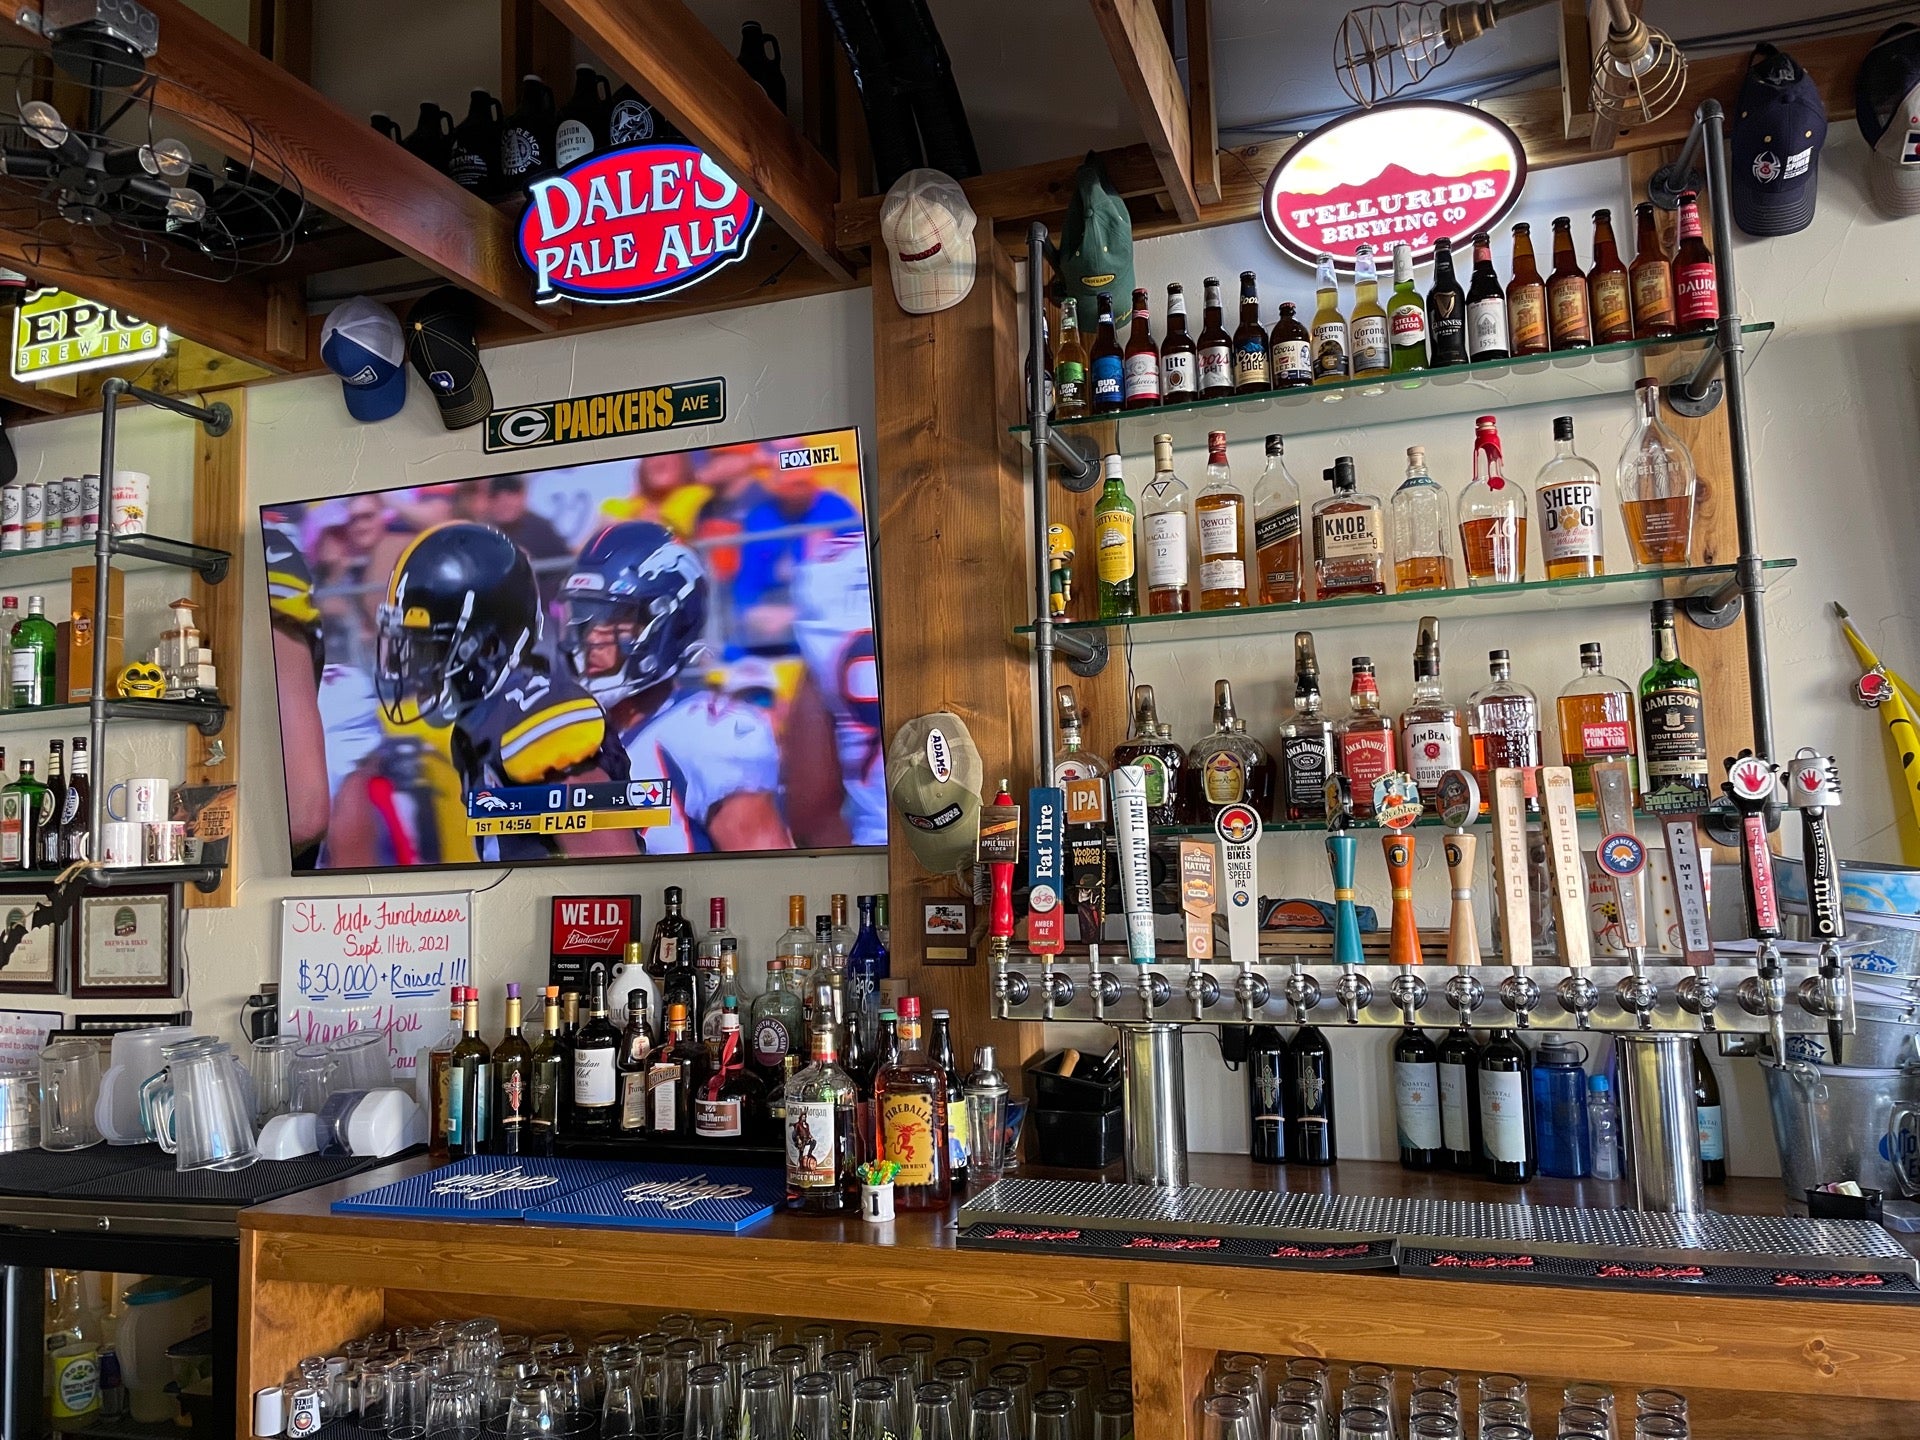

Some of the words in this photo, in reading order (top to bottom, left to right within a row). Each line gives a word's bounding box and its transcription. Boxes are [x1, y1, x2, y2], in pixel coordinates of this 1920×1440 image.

[529, 152, 739, 242] DALE'S
[1291, 179, 1496, 228] TELLURIDE
[1321, 212, 1438, 244] BREWING
[535, 232, 637, 293] PALE
[654, 214, 739, 273] ALE
[1395, 317, 1419, 326] STELLA
[1395, 322, 1420, 332] ARTOIS
[1432, 319, 1462, 330] GUINNESS
[1313, 326, 1344, 337] Corona
[1354, 328, 1385, 340] Corona
[1480, 338, 1497, 347] 1554
[20, 330, 153, 368] BREWING
[1274, 343, 1295, 355] Coors
[1236, 351, 1267, 363] Coors
[1165, 356, 1186, 372] Lite
[1241, 362, 1263, 371] EDGE
[1276, 363, 1296, 371] BEER
[1096, 385, 1120, 394] LIGHT
[555, 386, 673, 441] PACKERS
[681, 394, 710, 412] AVE
[780, 451, 810, 468] FOX
[813, 447, 839, 463] NFL
[1543, 486, 1592, 509] SHEEP
[1114, 514, 1133, 524] SARK
[1201, 517, 1234, 528] Dewar's
[1257, 522, 1277, 535] BLACK
[1277, 514, 1299, 528] LABEL
[1325, 515, 1365, 536] KNOB
[1147, 533, 1180, 541] MACALLAN
[1333, 531, 1374, 542] CREEK
[1556, 537, 1586, 546] Whiskey
[1372, 539, 1378, 550] 9
[1157, 549, 1167, 557] 12
[1645, 695, 1699, 712] JAMESON
[1584, 727, 1625, 737] PRINCESS
[1411, 731, 1427, 748] JIM
[1427, 729, 1451, 745] BEAM
[1585, 737, 1605, 747] YUM
[1607, 736, 1626, 746] YUM
[1286, 743, 1302, 758] JACK
[1302, 741, 1327, 757] DANIEL'S
[1345, 740, 1361, 755] JACK
[1361, 738, 1387, 752] DANIEL'S
[933, 735, 947, 775] ADAMS
[1208, 776, 1222, 784] Crown
[1222, 776, 1238, 784] Royal
[549, 789, 562, 808] 0
[573, 789, 586, 807] 0
[612, 797, 625, 805] 1-3
[1072, 791, 1099, 811] IPA
[509, 802, 522, 810] 3-1
[1382, 804, 1418, 820] Beehive
[1646, 802, 1707, 811] BREWING
[203, 811, 230, 820] BEHIND
[1130, 798, 1145, 832] TIME
[476, 822, 491, 832] 1ST
[500, 819, 532, 831] 14:56
[545, 815, 587, 831] FLAG
[1037, 804, 1053, 843] Tire
[1812, 821, 1823, 846] MILK
[1605, 840, 1620, 855] DENVER
[1619, 839, 1633, 848] BEER
[1675, 828, 1687, 855] ALL
[1073, 848, 1100, 857] VOODOO
[1227, 851, 1251, 860] BIKES
[1037, 846, 1053, 878] Fat
[1074, 855, 1101, 865] RANGER
[1184, 856, 1211, 864] COLORADO
[1817, 847, 1826, 877] STOUT
[1133, 837, 1150, 908] MOUNTAIN
[1184, 862, 1211, 872] NATIVE
[1228, 862, 1251, 871] SINGLE
[1229, 870, 1251, 880] SPEED
[1680, 864, 1694, 891] MTN
[1235, 879, 1246, 888] IPA
[1759, 886, 1771, 924] Dreams
[292, 902, 326, 933] St.
[333, 904, 371, 935] Jude
[374, 901, 466, 930] Fundraiser
[562, 904, 589, 925] WE
[594, 904, 623, 925] I.D.
[1035, 920, 1054, 928] AMBER
[1039, 927, 1049, 935] ALE
[568, 935, 614, 944] Budweiser
[343, 934, 383, 963] Sept.
[418, 935, 448, 952] 2021
[390, 962, 446, 992] Raised
[16, 1027, 36, 1035] please
[287, 1009, 363, 1045] Thank
[373, 1004, 423, 1057] You
[752, 1021, 770, 1049] PLYMOUTH
[771, 1021, 784, 1034] SLOE
[780, 1035, 788, 1049] GIN
[1482, 1090, 1511, 1098] COASTAL
[804, 1105, 827, 1117] Morgan
[885, 1103, 931, 1124] FIREBALL
